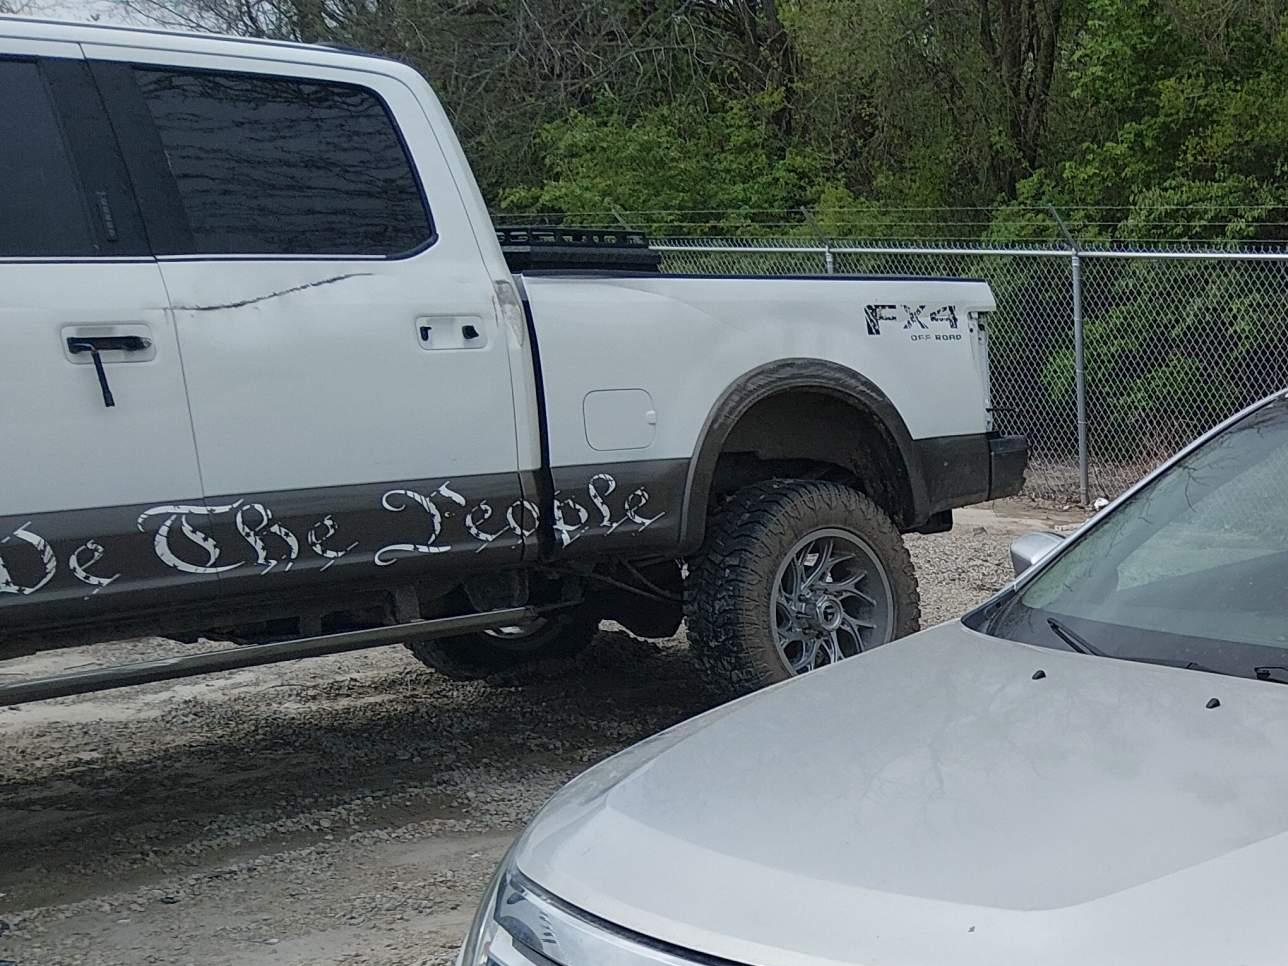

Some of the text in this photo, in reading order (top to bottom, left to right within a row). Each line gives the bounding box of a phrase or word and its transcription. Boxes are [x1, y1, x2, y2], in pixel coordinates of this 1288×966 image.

[864, 304, 959, 336] FX4
[910, 334, 962, 342] OFF ROAD
[137, 498, 359, 576] The
[374, 473, 665, 567] People
